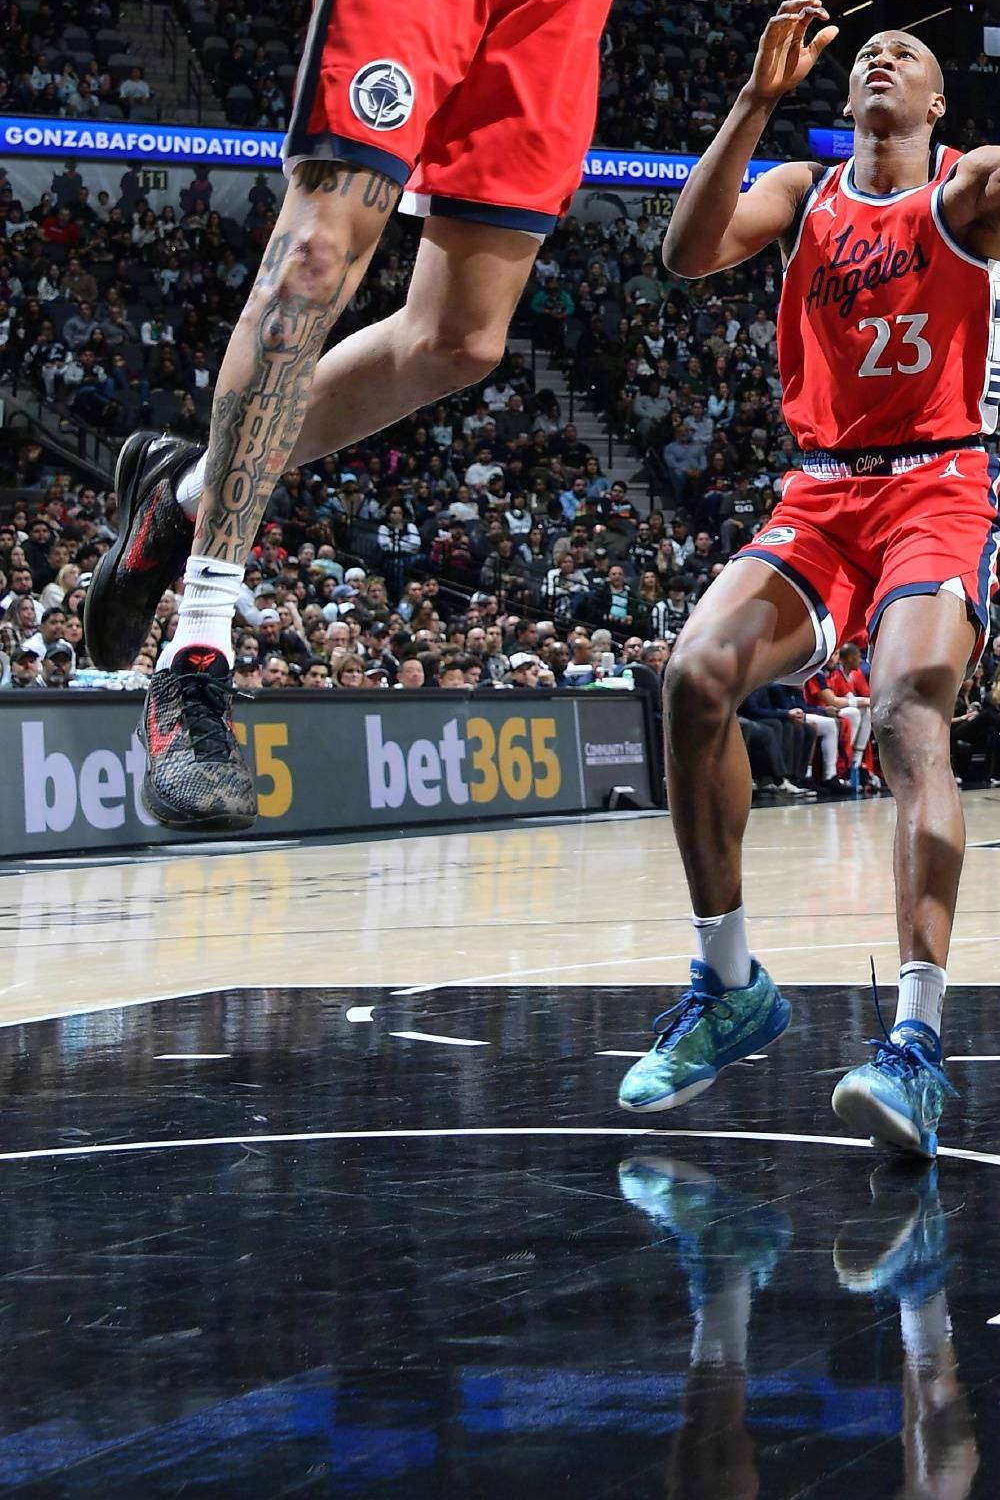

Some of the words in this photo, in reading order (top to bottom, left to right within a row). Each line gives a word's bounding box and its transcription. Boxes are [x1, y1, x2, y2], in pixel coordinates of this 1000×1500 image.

[136, 170, 168, 191] 111
[642, 199, 672, 216] 112
[829, 225, 886, 269] Los
[806, 239, 930, 318] Angeles
[858, 312, 933, 378] 23
[855, 453, 885, 474] Clips
[20, 720, 292, 834] bet5
[364, 714, 562, 809] bet365
